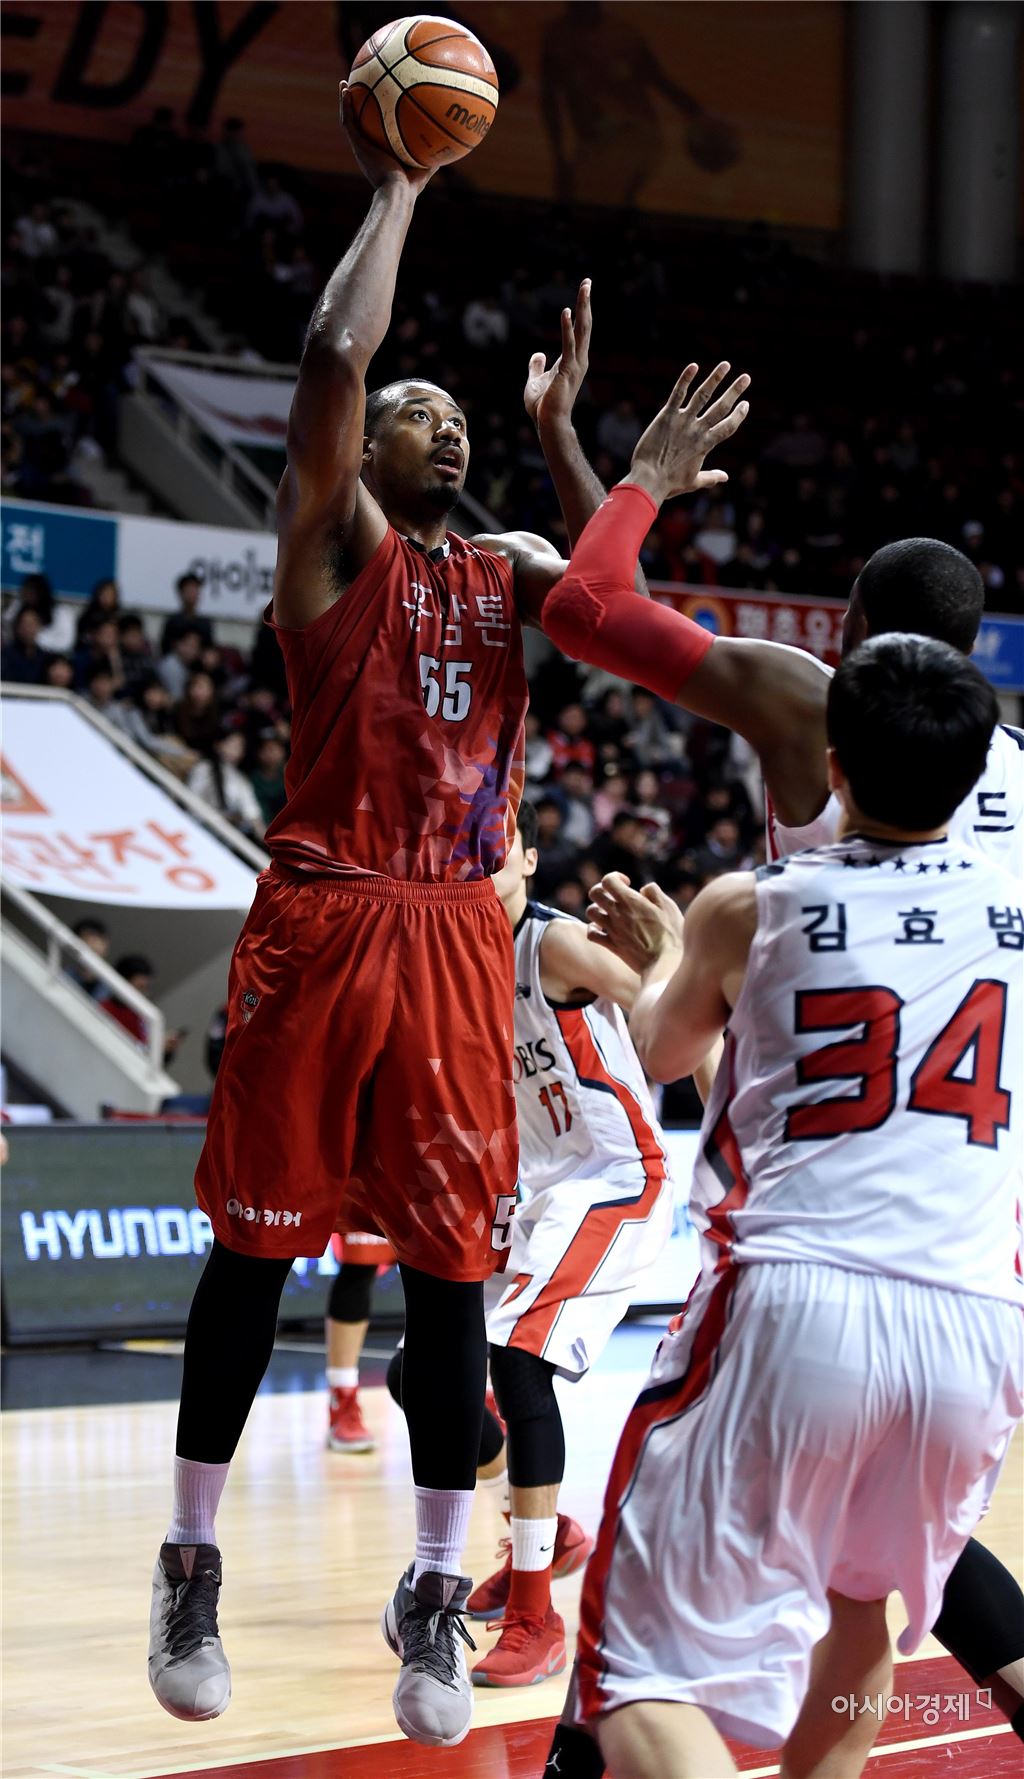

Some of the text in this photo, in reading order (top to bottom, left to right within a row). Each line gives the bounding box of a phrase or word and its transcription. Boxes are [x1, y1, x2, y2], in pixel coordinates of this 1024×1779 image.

[418, 653, 474, 722] 55
[783, 978, 1012, 1151] 34
[538, 1081, 573, 1137] 17
[21, 1208, 214, 1260] HYUNDA
